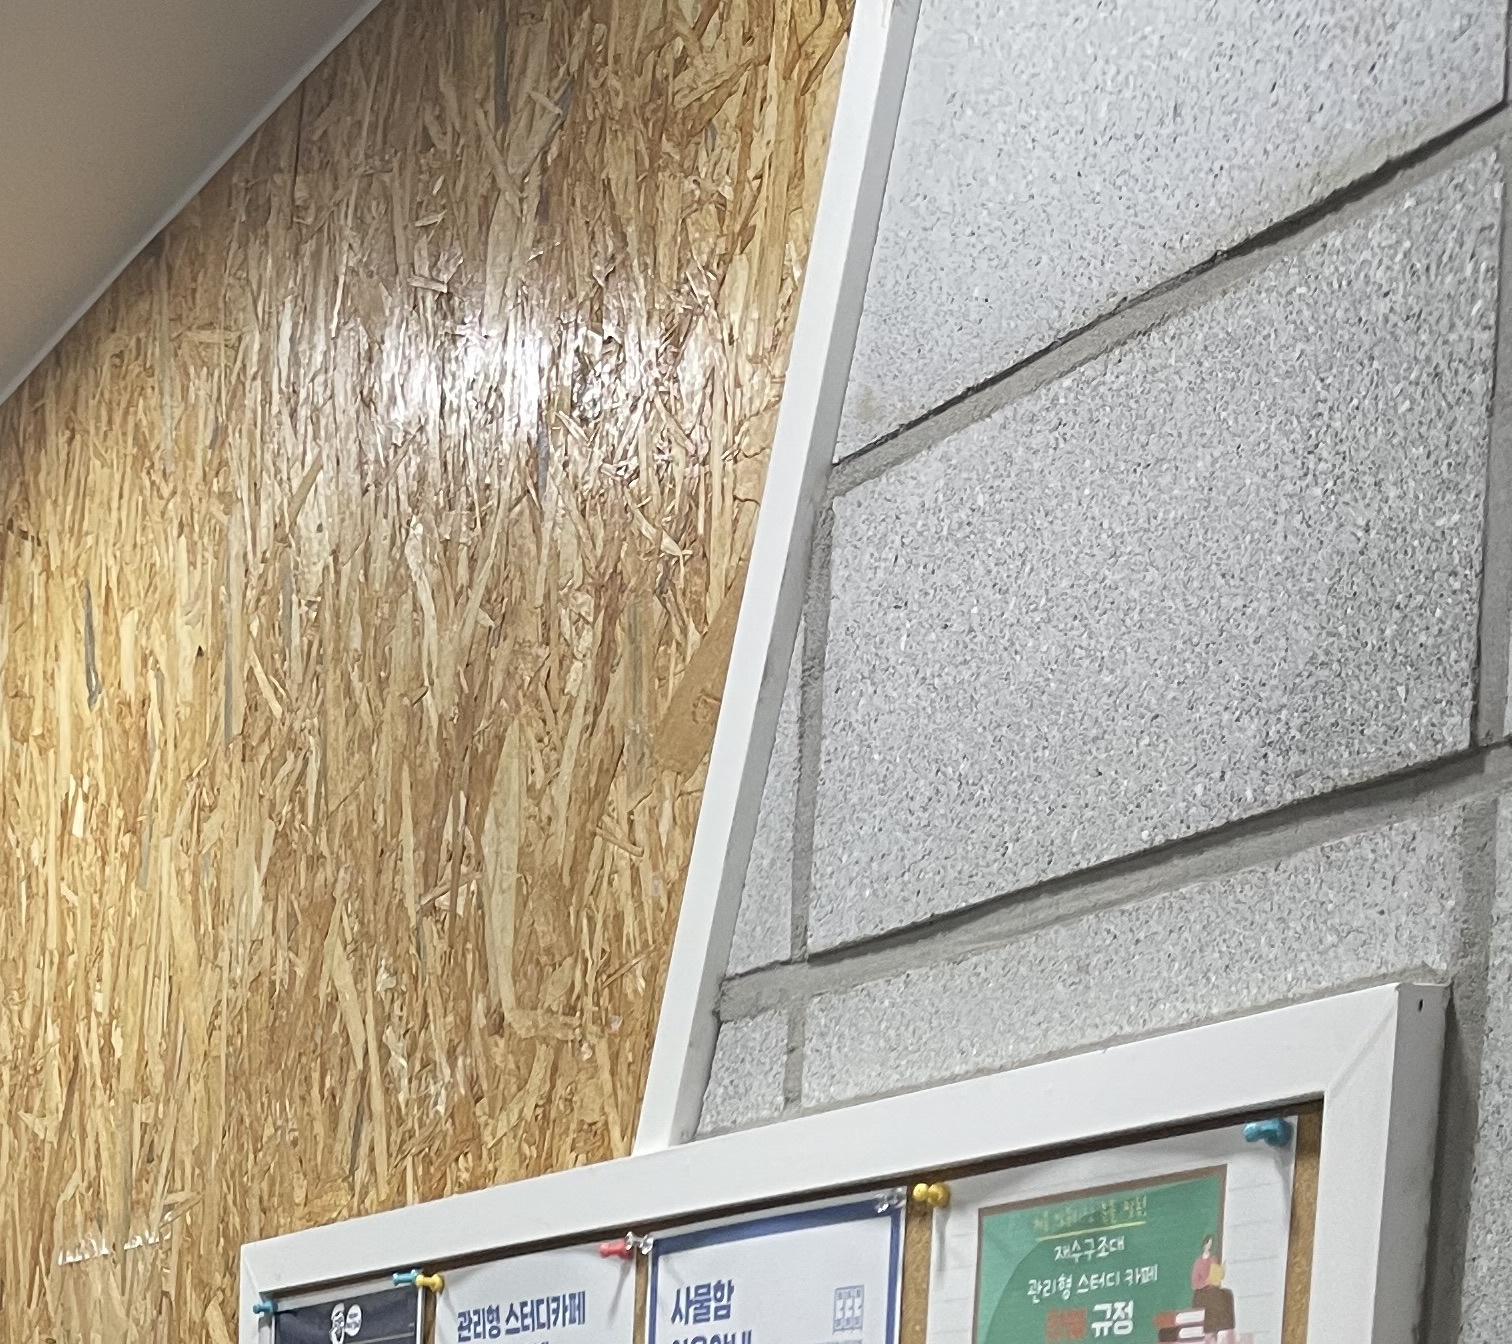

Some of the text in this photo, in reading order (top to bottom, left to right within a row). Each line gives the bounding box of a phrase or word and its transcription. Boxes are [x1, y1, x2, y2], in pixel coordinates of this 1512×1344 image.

[1054, 1236, 1125, 1263] 재수구조대
[671, 1279, 735, 1325] 사물함
[1027, 1264, 1158, 1304] 관리형 스터디 카페
[458, 1291, 586, 1343] 관리형 스터디카페
[1092, 1300, 1134, 1338] 규정
